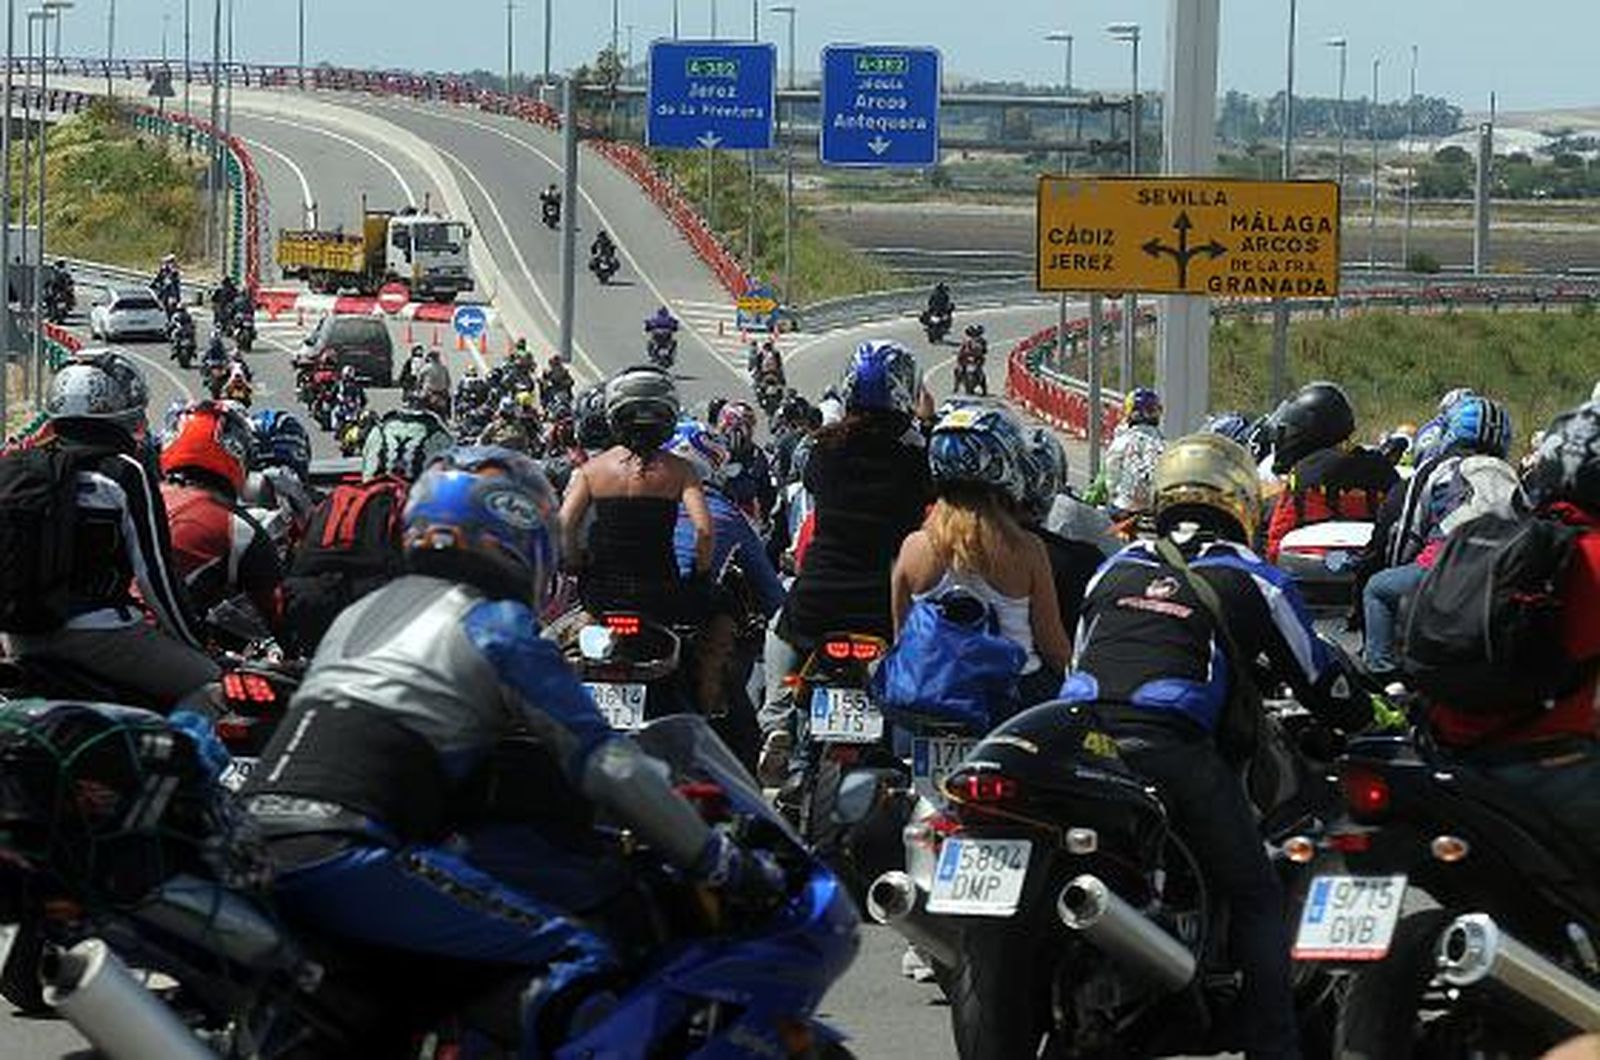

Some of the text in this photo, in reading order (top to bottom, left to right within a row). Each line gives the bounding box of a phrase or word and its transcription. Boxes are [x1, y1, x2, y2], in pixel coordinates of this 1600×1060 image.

[688, 82, 737, 98] Jerez
[656, 104, 675, 115] de
[680, 104, 696, 115] la
[855, 94, 909, 109] Arcos
[833, 113, 927, 132] Antequera
[1138, 188, 1227, 206] SEVILLA
[1230, 211, 1332, 233] MÁLAGA
[1048, 224, 1115, 245] CÁDIZ
[1240, 236, 1319, 253] ARCOS
[1049, 253, 1115, 271] JEREZ
[1230, 258, 1250, 273] DE
[1257, 258, 1278, 273] LA
[1207, 276, 1327, 293] GRANADA
[959, 843, 1022, 872] 5804
[1331, 880, 1393, 910] 9715
